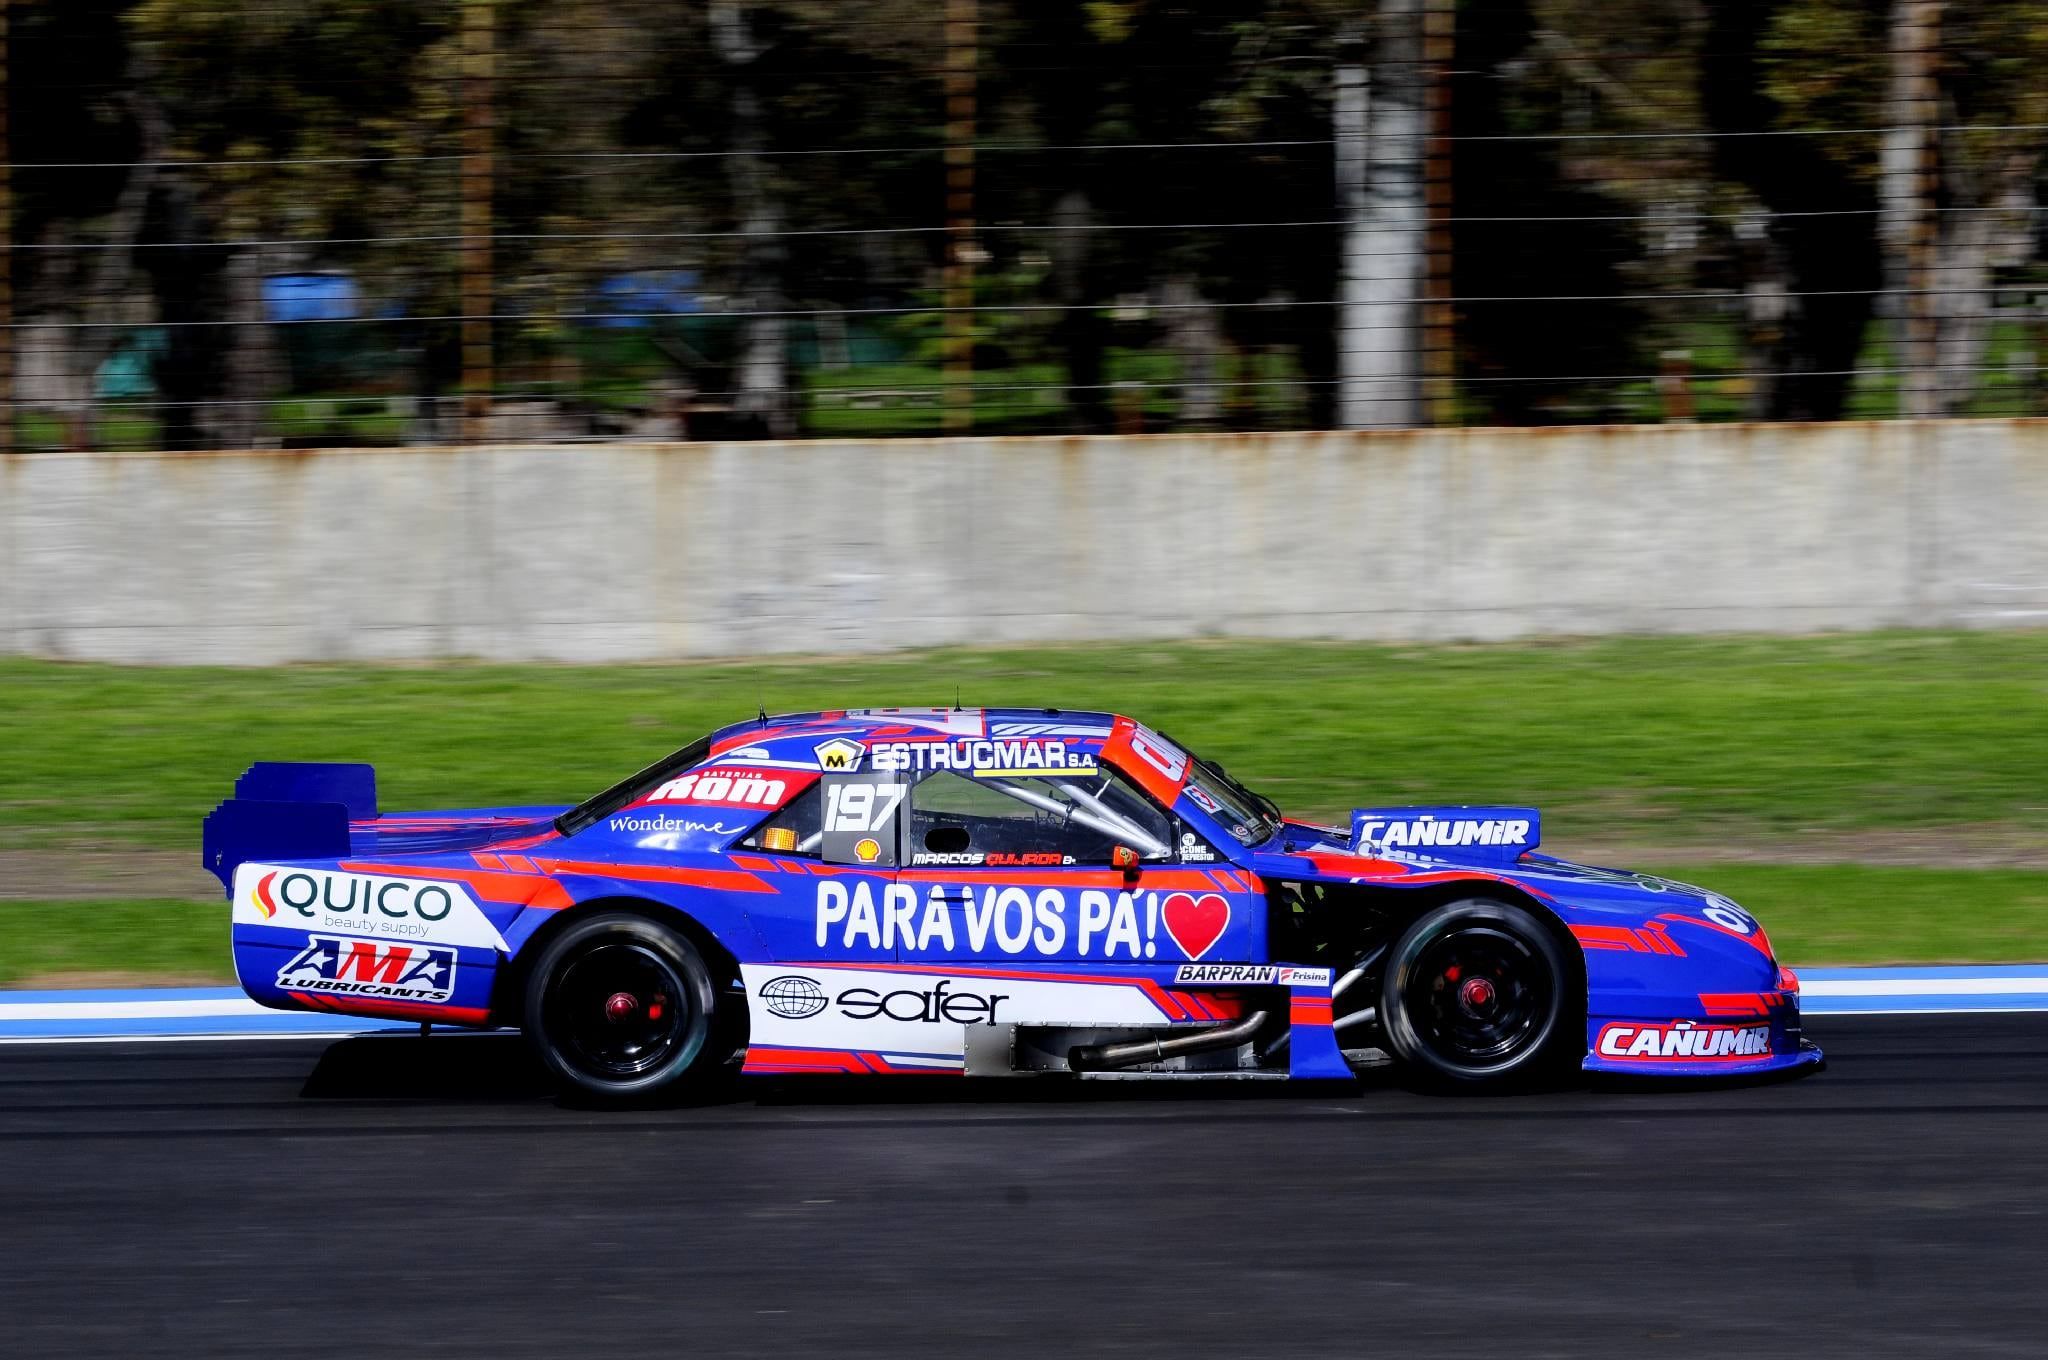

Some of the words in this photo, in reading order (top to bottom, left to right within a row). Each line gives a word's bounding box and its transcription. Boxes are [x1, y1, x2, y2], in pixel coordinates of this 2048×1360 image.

[871, 741, 1067, 770] ESTRUCMAR
[1068, 753, 1097, 768] S.A.
[824, 784, 908, 832] 197
[912, 853, 985, 865] MARCOS
[986, 853, 1063, 866] QUIJADA
[280, 873, 452, 922] QUICO
[324, 915, 377, 933] beauty
[381, 922, 430, 937] supply
[816, 880, 955, 952] PARA
[962, 884, 1067, 956] VOS
[283, 938, 454, 990] AMA
[1179, 966, 1273, 981] BARPRAN
[1292, 971, 1327, 981] Frisina
[279, 978, 447, 999] LUBRICANTS
[836, 980, 1009, 1027] safer
